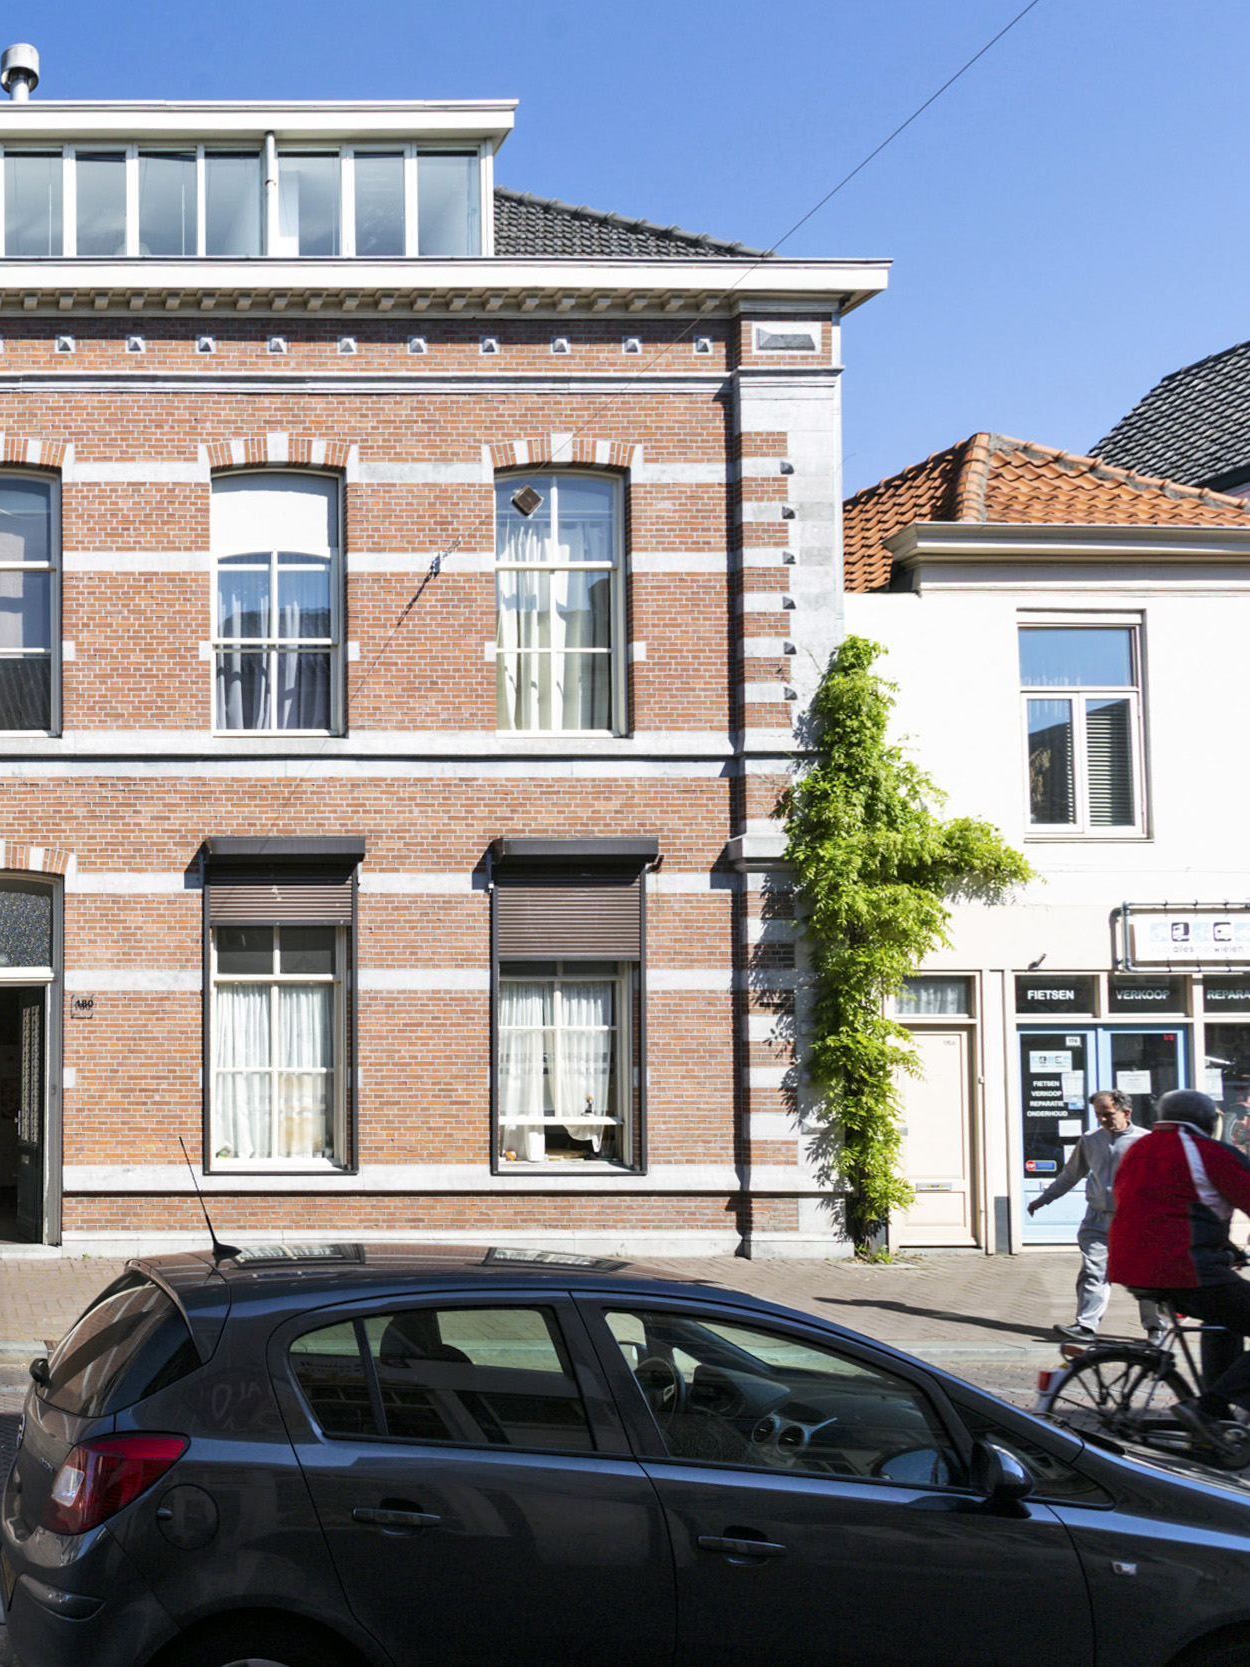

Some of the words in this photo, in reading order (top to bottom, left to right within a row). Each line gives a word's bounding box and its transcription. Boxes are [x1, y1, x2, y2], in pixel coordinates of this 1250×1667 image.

[1027, 990, 1075, 1000] FIETSEN
[1116, 990, 1170, 1000] VERKOOP
[76, 999, 94, 1008] 180
[1027, 1110, 1068, 1118] ONDERHOUD
